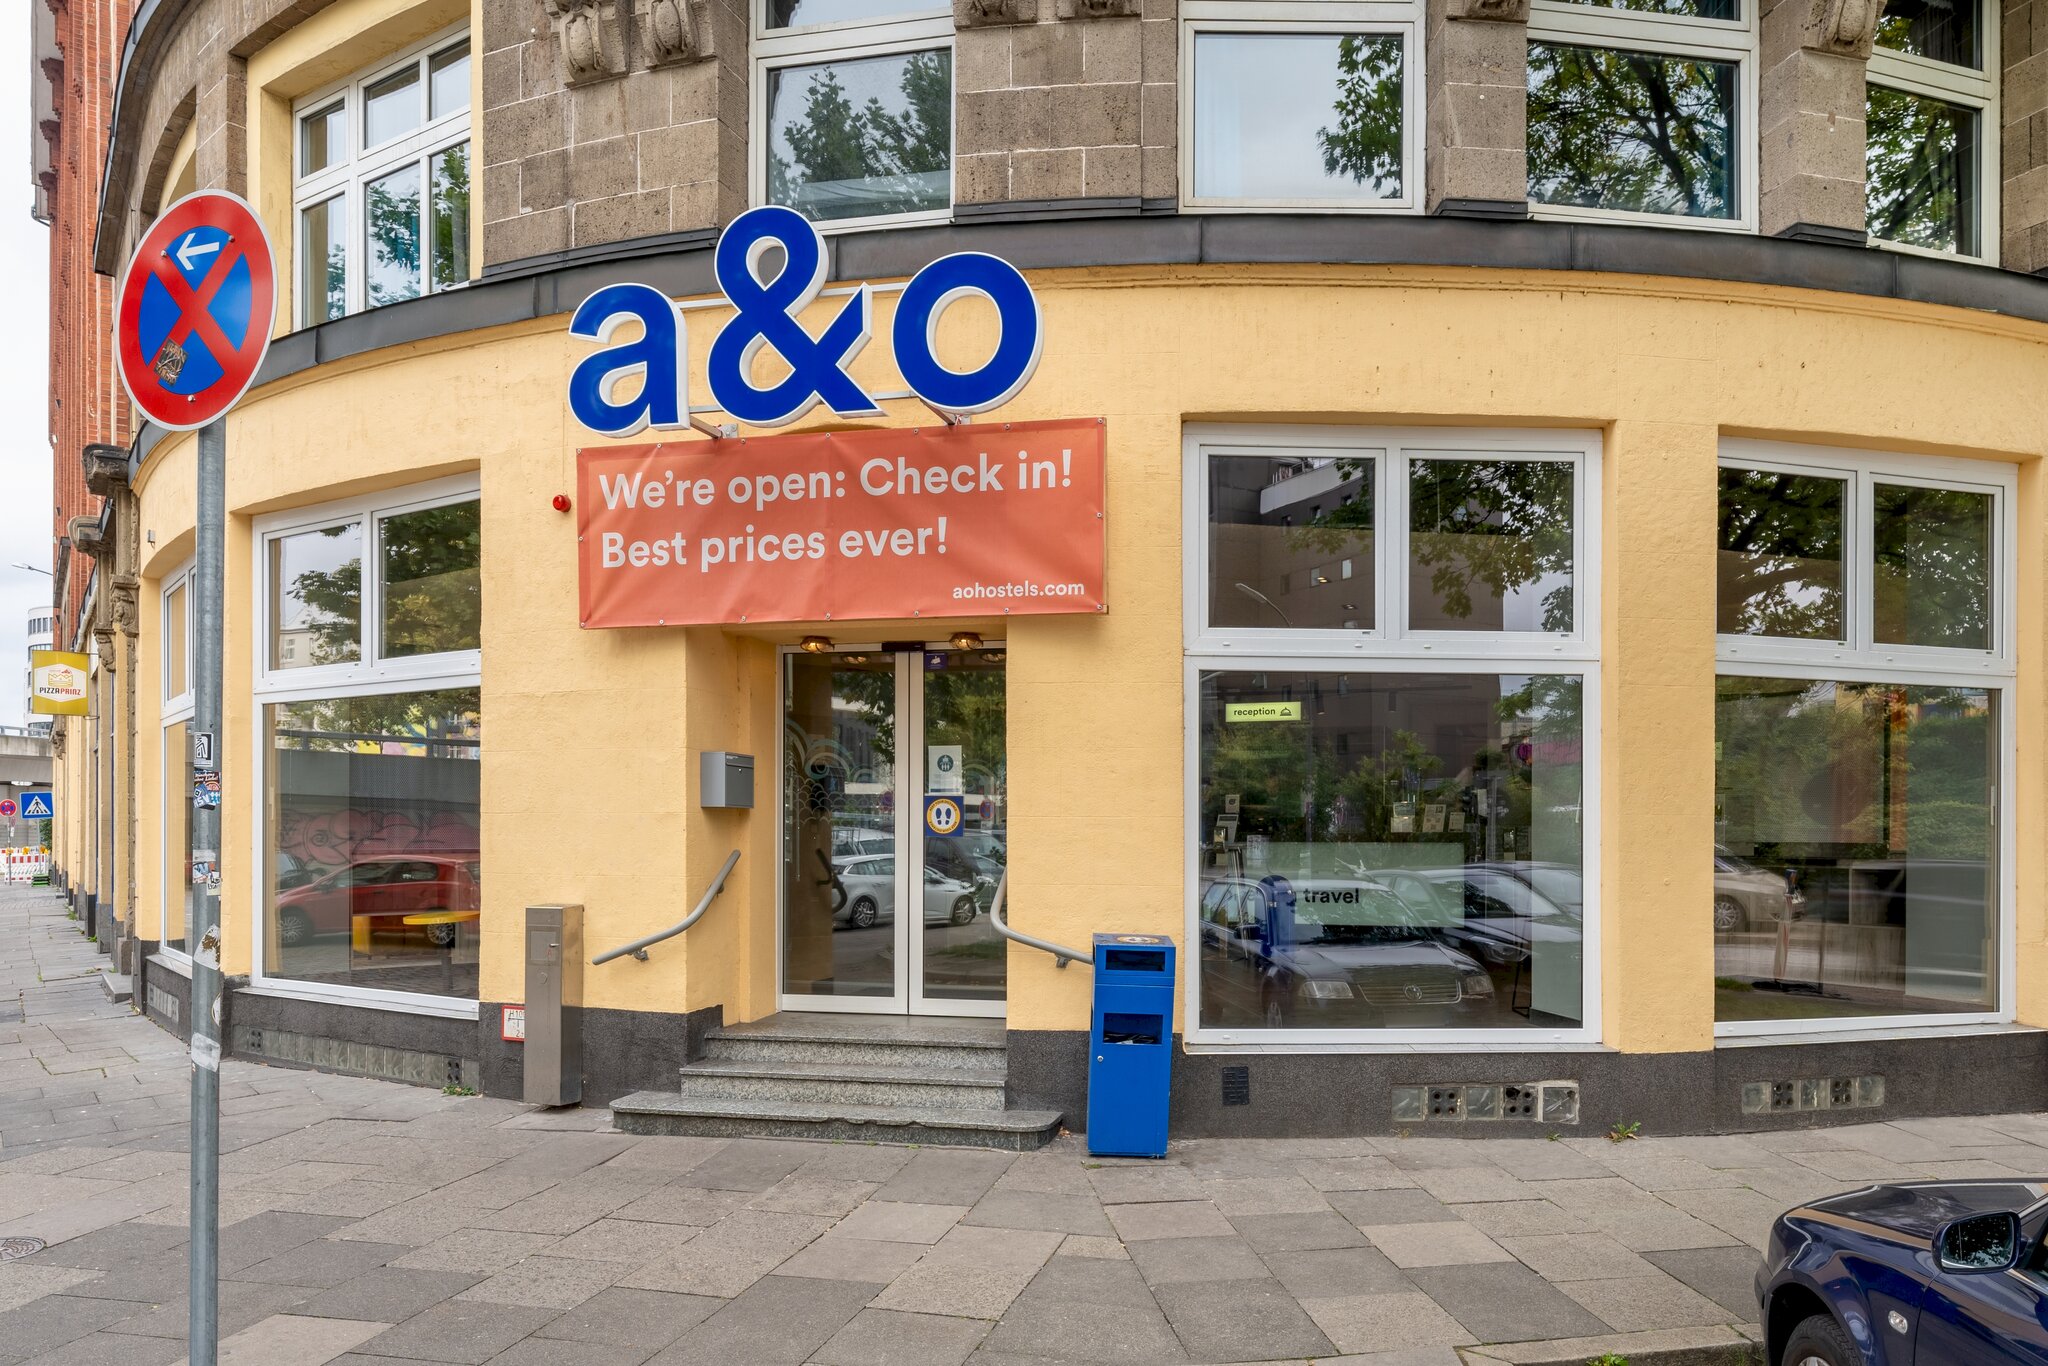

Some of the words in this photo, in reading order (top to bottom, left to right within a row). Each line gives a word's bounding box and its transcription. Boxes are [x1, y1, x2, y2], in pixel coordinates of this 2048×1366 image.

[568, 205, 1044, 438] a&o
[599, 470, 715, 510] We’re
[727, 471, 845, 511] open:
[860, 453, 1004, 496] Check
[1018, 449, 1072, 490] in!
[602, 532, 687, 568] Best
[701, 524, 826, 573] prices
[838, 517, 948, 558] ever!
[953, 580, 1085, 599] aohostels.com
[1233, 707, 1276, 717] reception
[1303, 888, 1360, 904] travel
